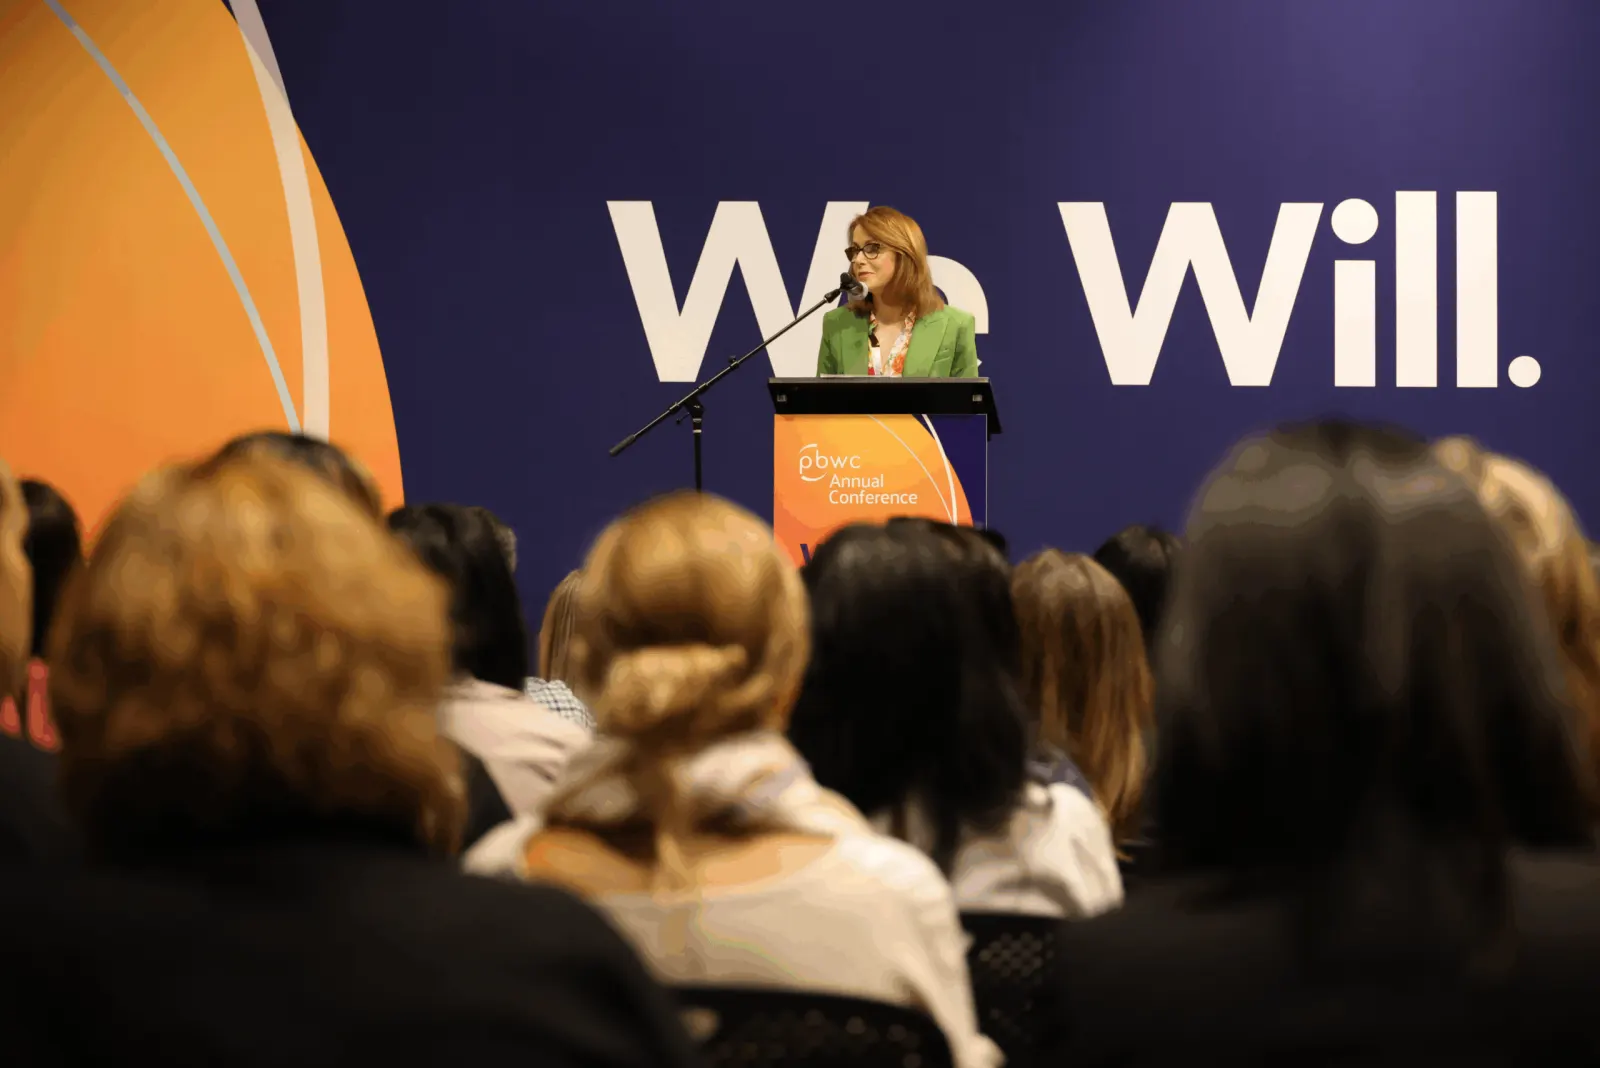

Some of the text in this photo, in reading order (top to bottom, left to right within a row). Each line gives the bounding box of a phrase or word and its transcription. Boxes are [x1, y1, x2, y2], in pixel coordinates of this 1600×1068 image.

[1057, 190, 1542, 388] Will.
[799, 449, 861, 475] pbwc
[829, 473, 884, 488] Annual
[828, 489, 918, 504] Conference
